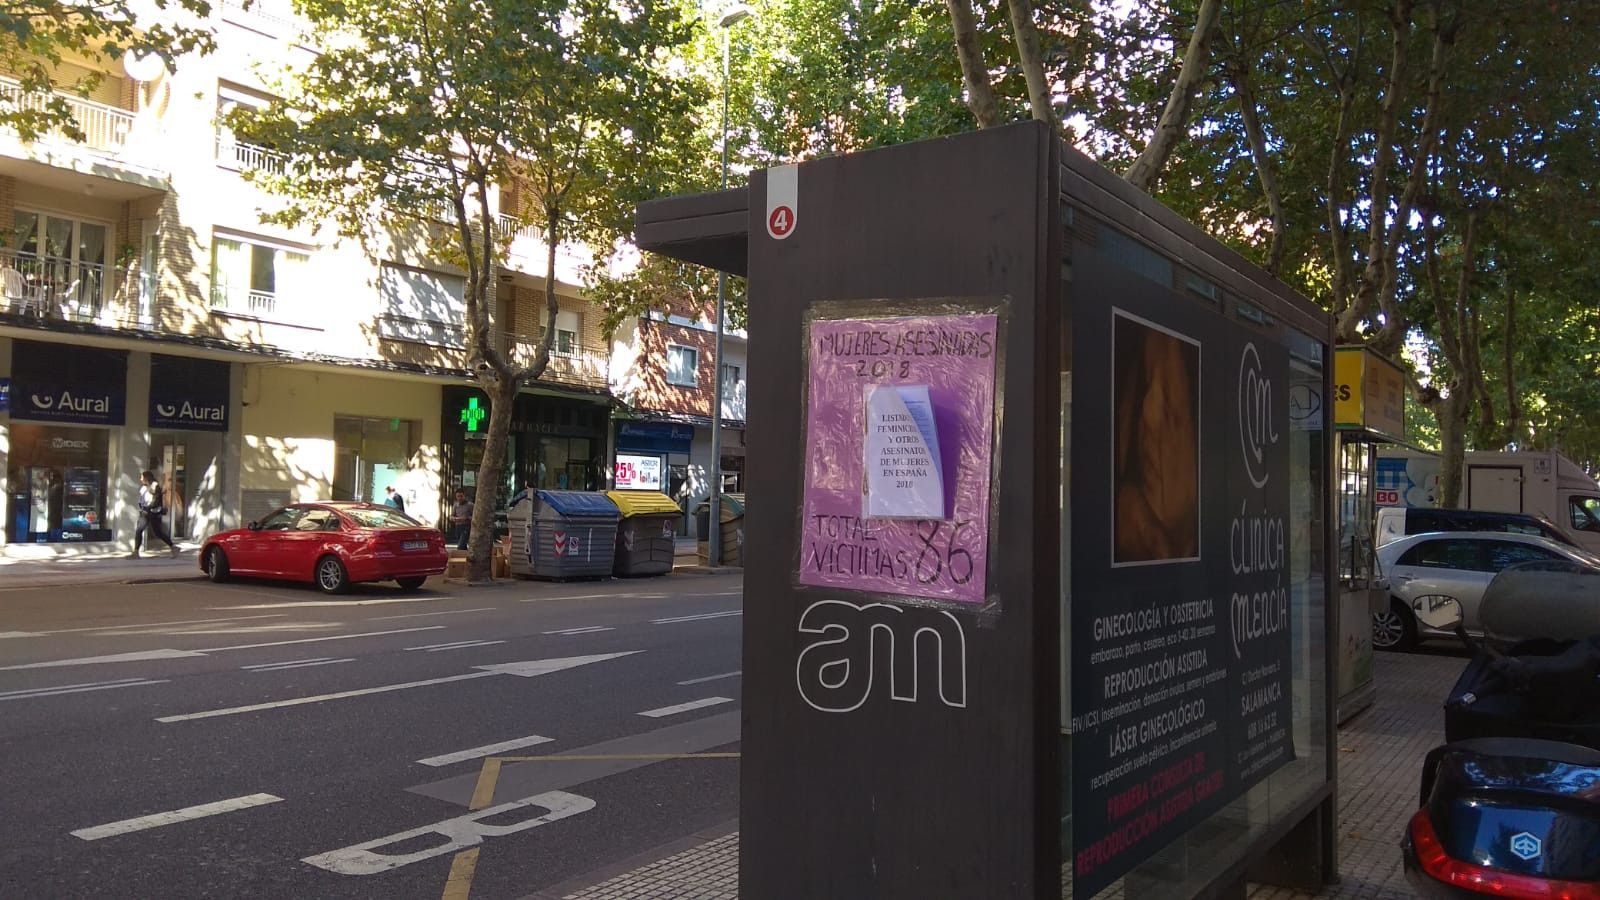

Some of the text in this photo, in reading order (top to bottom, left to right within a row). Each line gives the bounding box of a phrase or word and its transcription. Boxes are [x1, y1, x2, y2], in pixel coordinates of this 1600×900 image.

[774, 209, 788, 231] 4
[819, 325, 992, 358] MUJERES ASESINADAS
[58, 391, 109, 413] Aural
[179, 401, 225, 420] Aural
[888, 436, 894, 444] Y
[880, 458, 929, 466] DE MUJERES
[883, 467, 928, 477] EN ESPAÑA
[812, 514, 878, 541] TOTAL
[916, 520, 974, 585] 86
[1094, 599, 1214, 641] GINECOLOGÍA Y OBSTETRICIA
[1104, 648, 1208, 699] REPRODUCCIÓN ASISTIDA
[1241, 681, 1283, 717] SALAMANCA
[1110, 723, 1139, 758] LÁSER
[1140, 698, 1205, 743] GINECOLÓGICO
